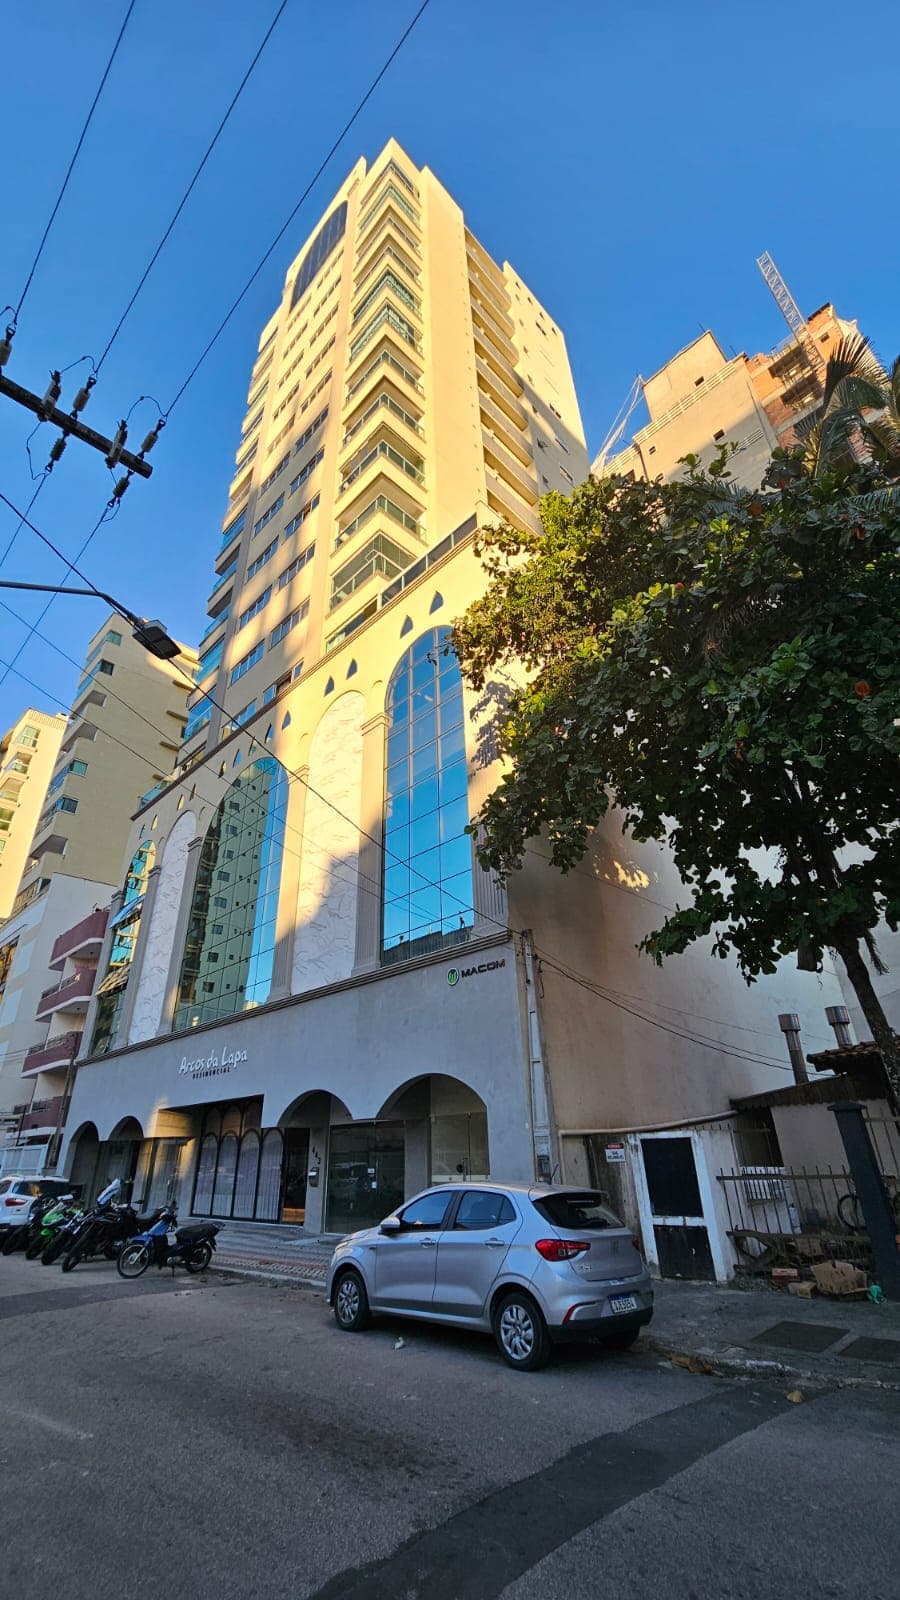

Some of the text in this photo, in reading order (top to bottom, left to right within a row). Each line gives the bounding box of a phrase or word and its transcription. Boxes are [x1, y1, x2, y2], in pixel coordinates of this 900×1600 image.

[461, 959, 505, 978] MACOM
[179, 1046, 248, 1074] Arcos da Lapa
